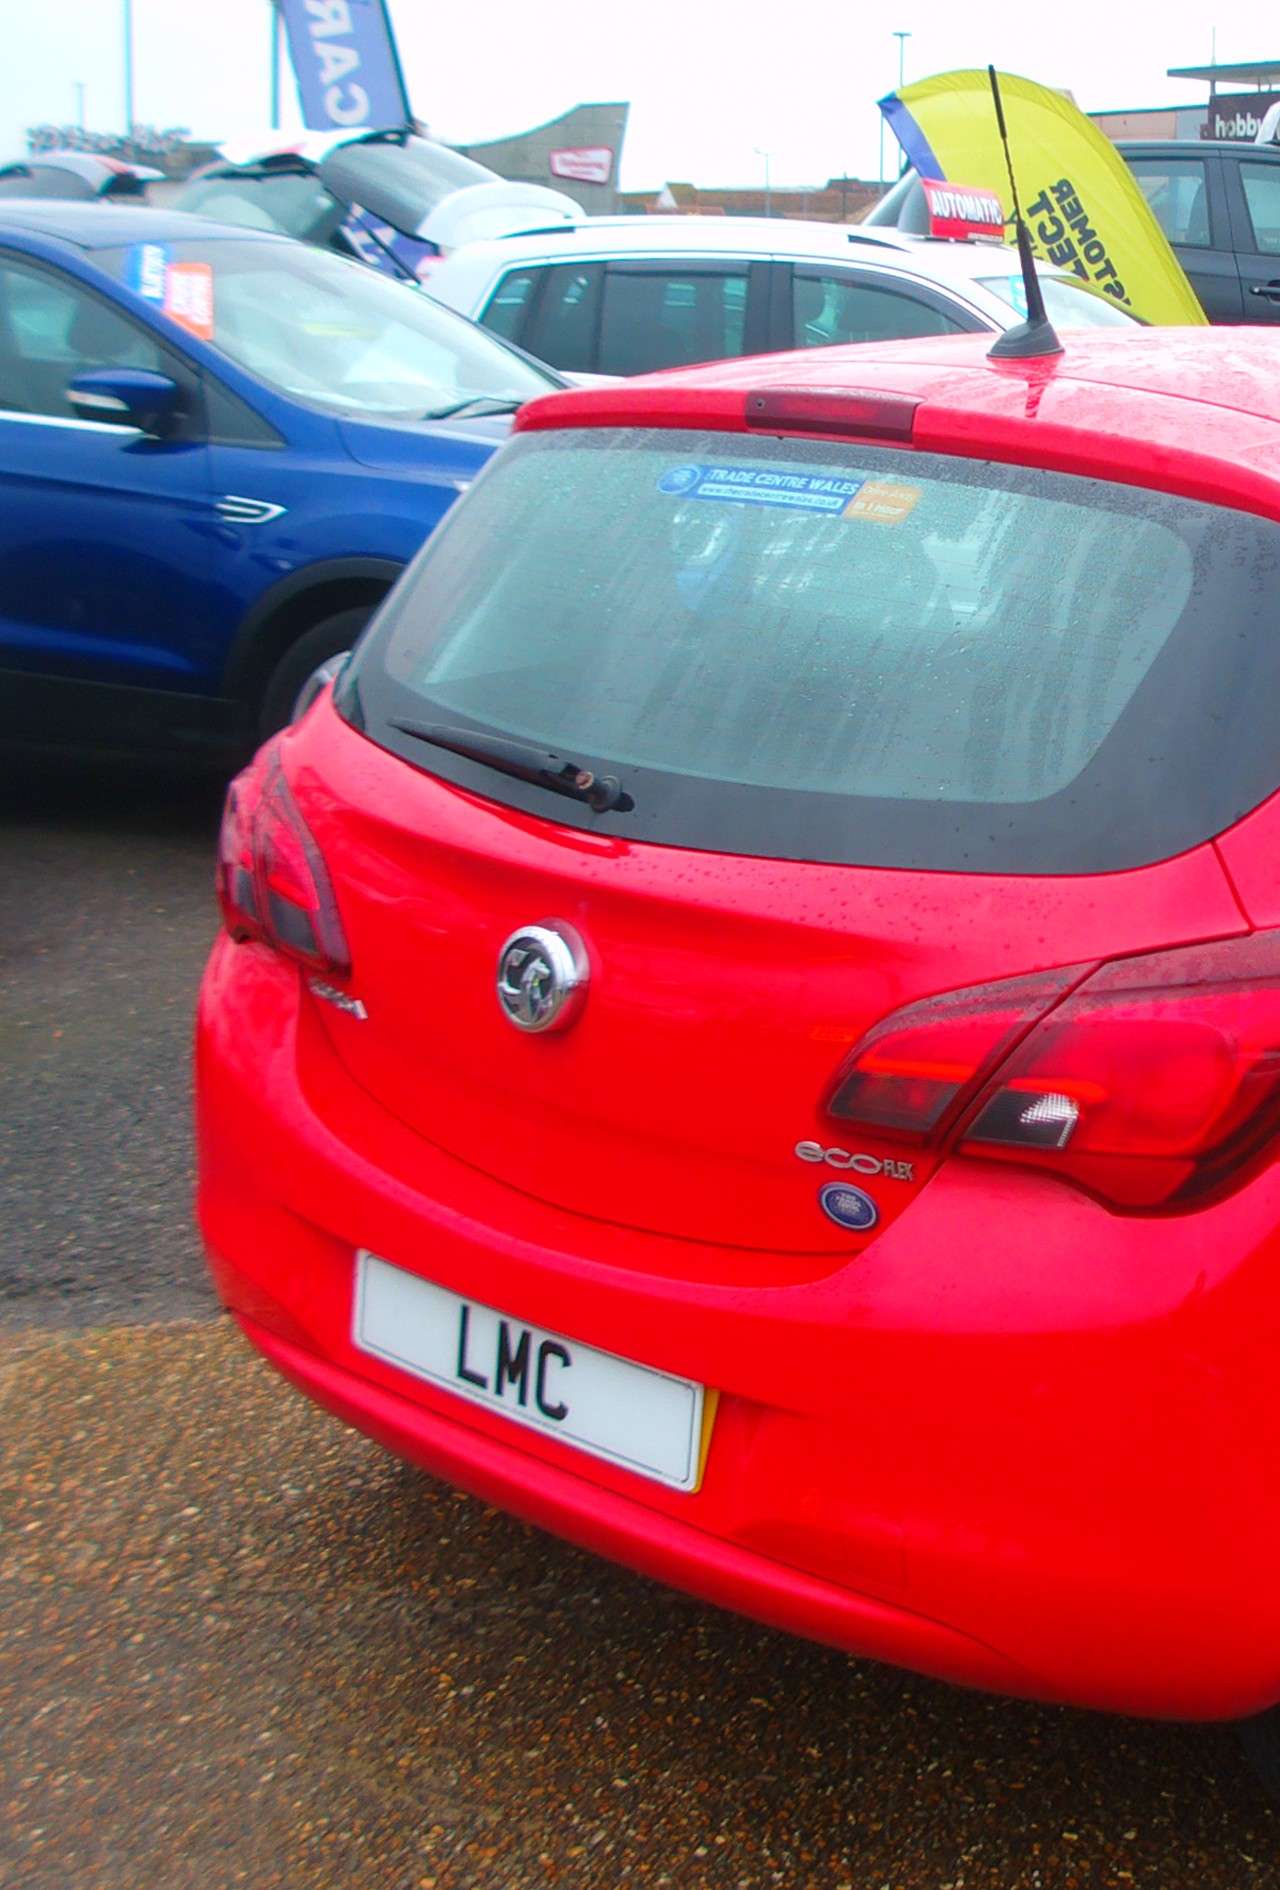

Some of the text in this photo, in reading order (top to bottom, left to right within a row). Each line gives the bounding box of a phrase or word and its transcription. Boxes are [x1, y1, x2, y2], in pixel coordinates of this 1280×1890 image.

[456, 304, 573, 421] LMC
[709, 469, 757, 483] TRADE
[755, 474, 809, 490] CENTRE
[809, 478, 861, 495] WALES
